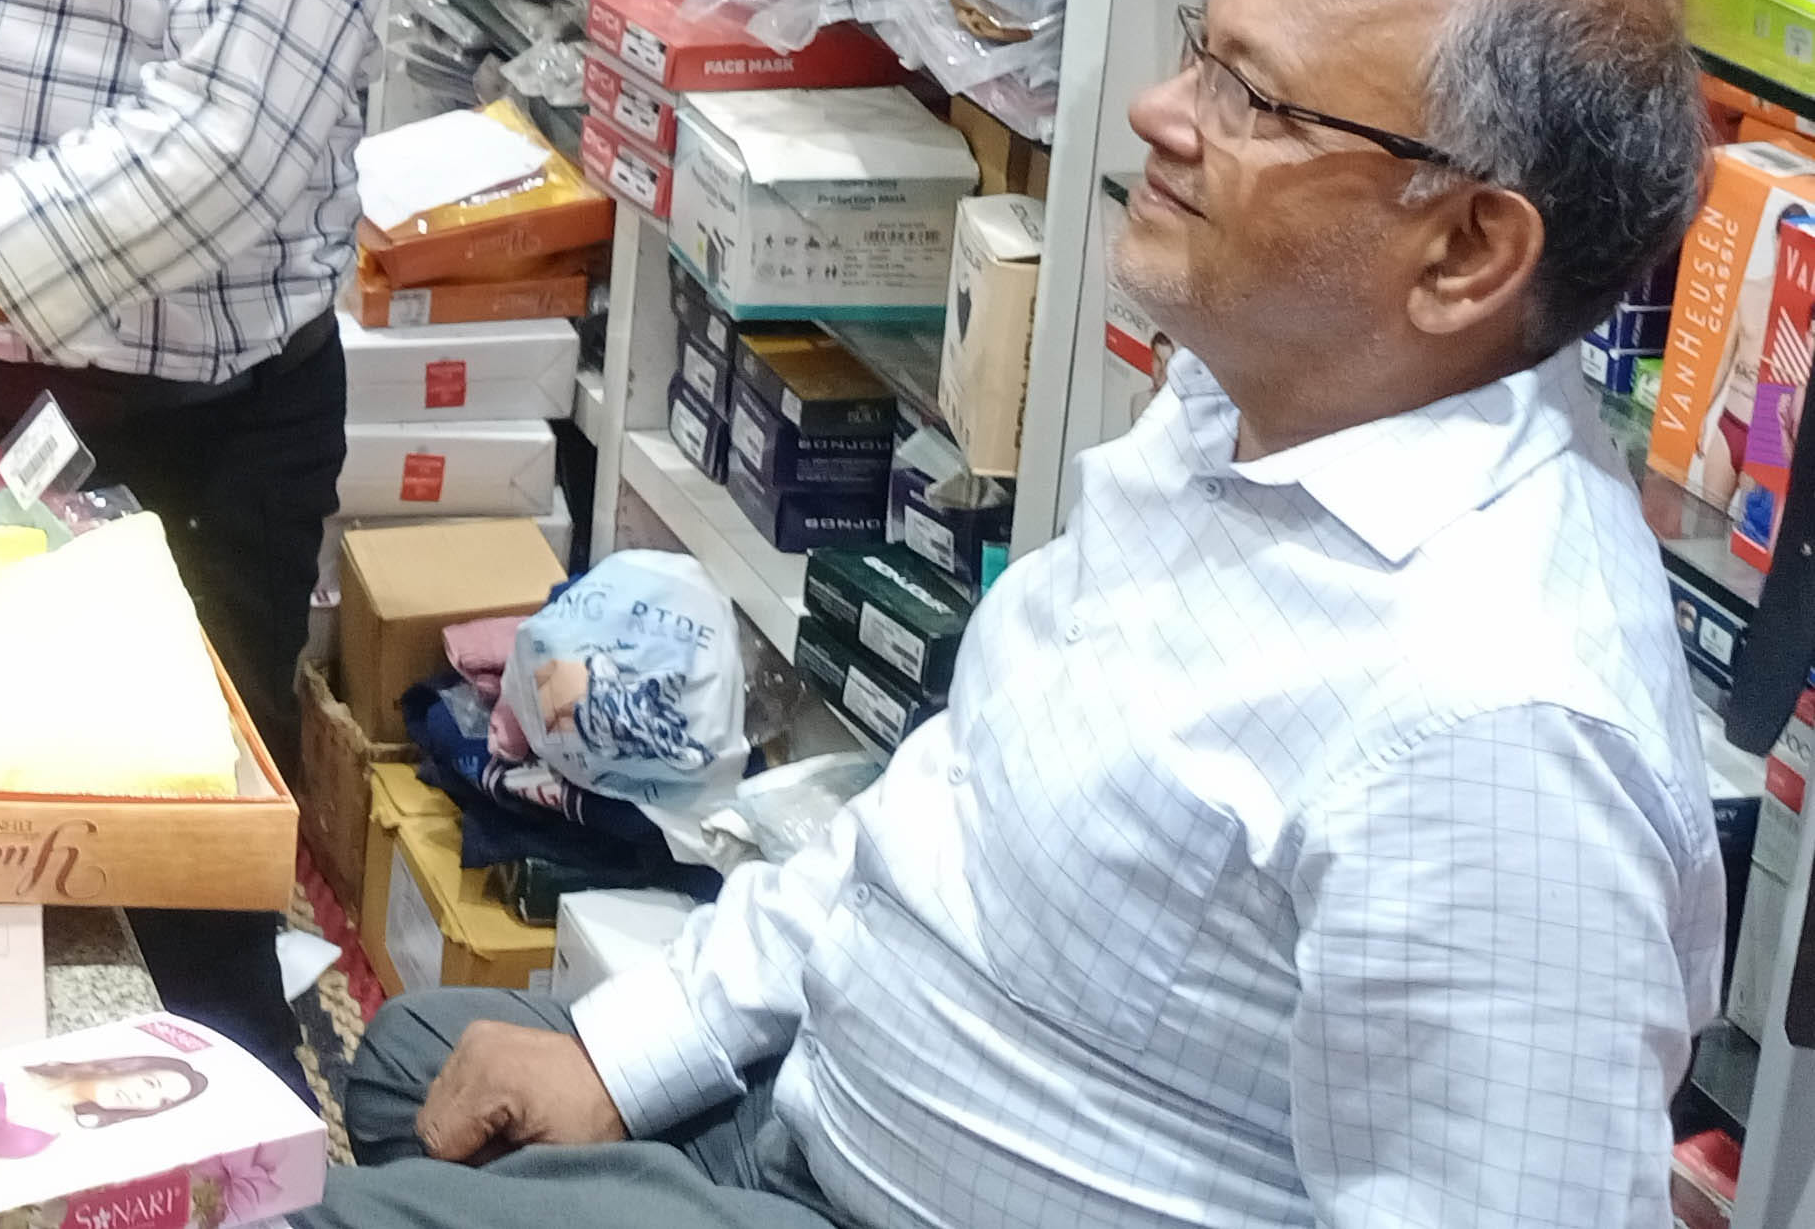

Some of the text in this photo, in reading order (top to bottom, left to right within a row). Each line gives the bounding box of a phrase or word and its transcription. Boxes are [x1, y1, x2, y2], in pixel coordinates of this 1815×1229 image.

[704, 57, 795, 74] FACE MASK
[1708, 220, 1739, 334] CLASSIC
